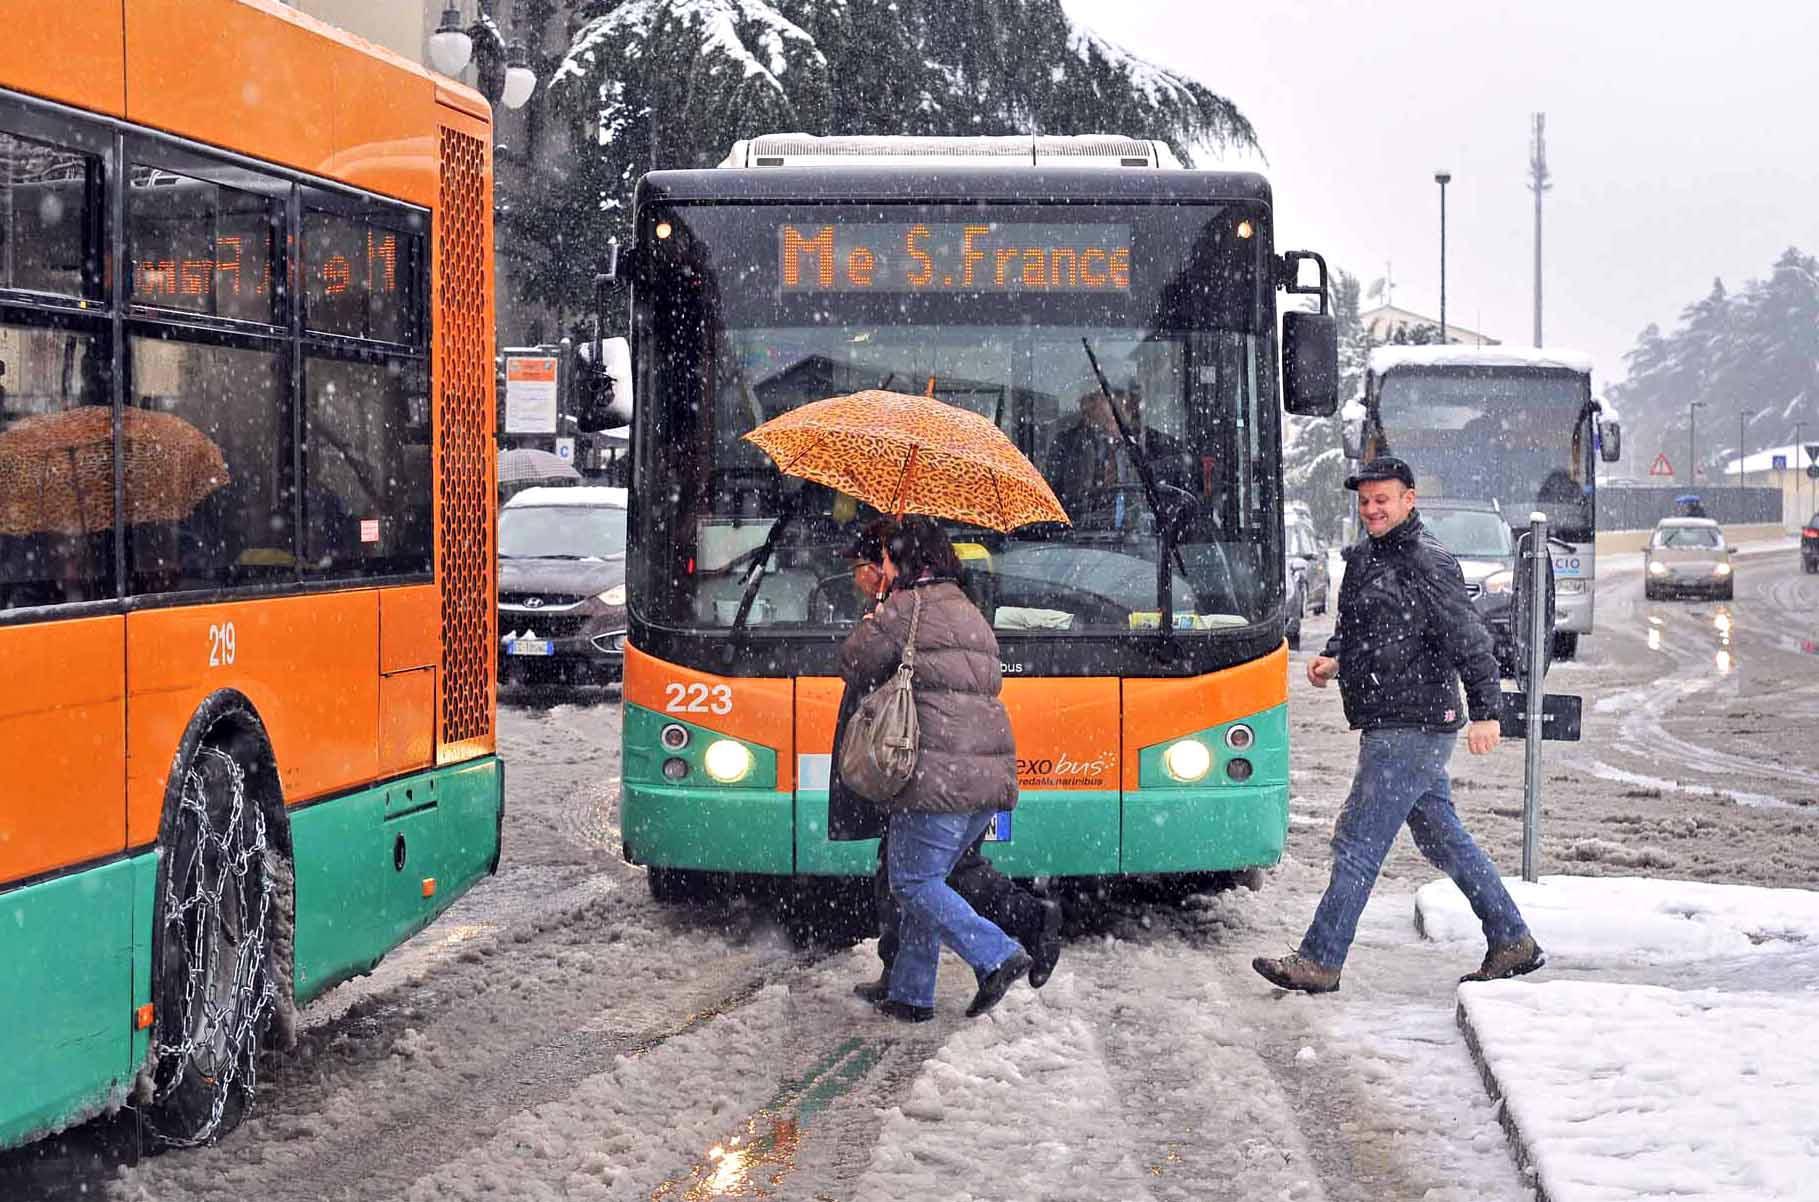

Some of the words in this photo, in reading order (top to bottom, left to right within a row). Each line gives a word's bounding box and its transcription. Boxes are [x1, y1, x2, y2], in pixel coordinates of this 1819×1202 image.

[906, 224, 1129, 288] S.France
[560, 446, 569, 457] C
[209, 621, 236, 667] 219
[1000, 661, 1023, 673] bus
[665, 682, 734, 715] 223
[1055, 752, 1105, 777] bus
[1018, 776, 1104, 786] redaMnarinibus
